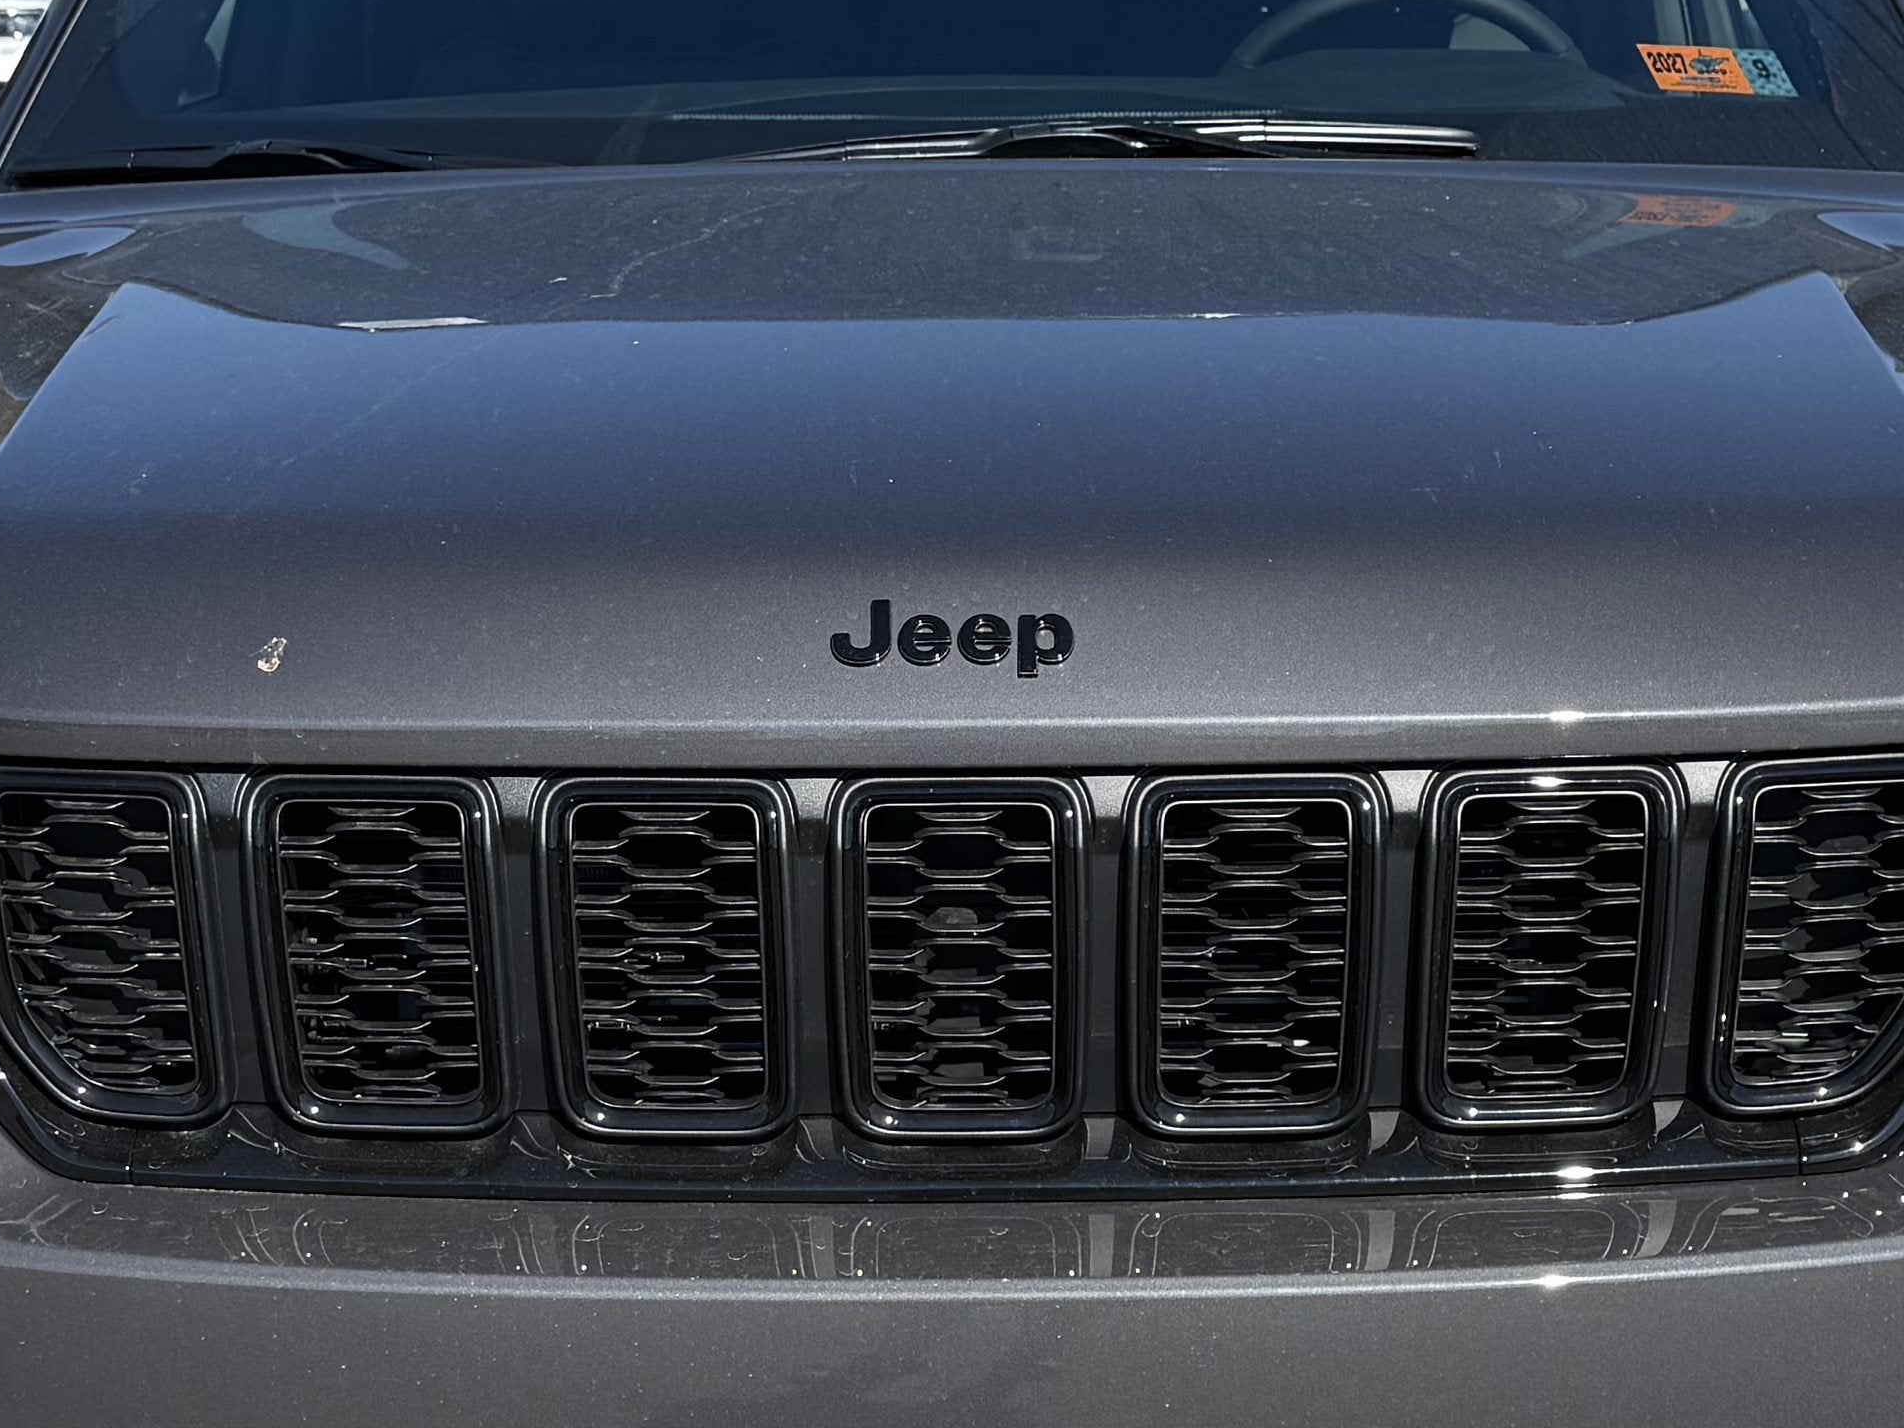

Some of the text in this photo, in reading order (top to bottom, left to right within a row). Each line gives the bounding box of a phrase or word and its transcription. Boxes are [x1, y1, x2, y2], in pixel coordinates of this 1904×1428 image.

[1647, 52, 1689, 74] 2027
[1752, 58, 1771, 78] 9
[830, 599, 1075, 679] Jeep
